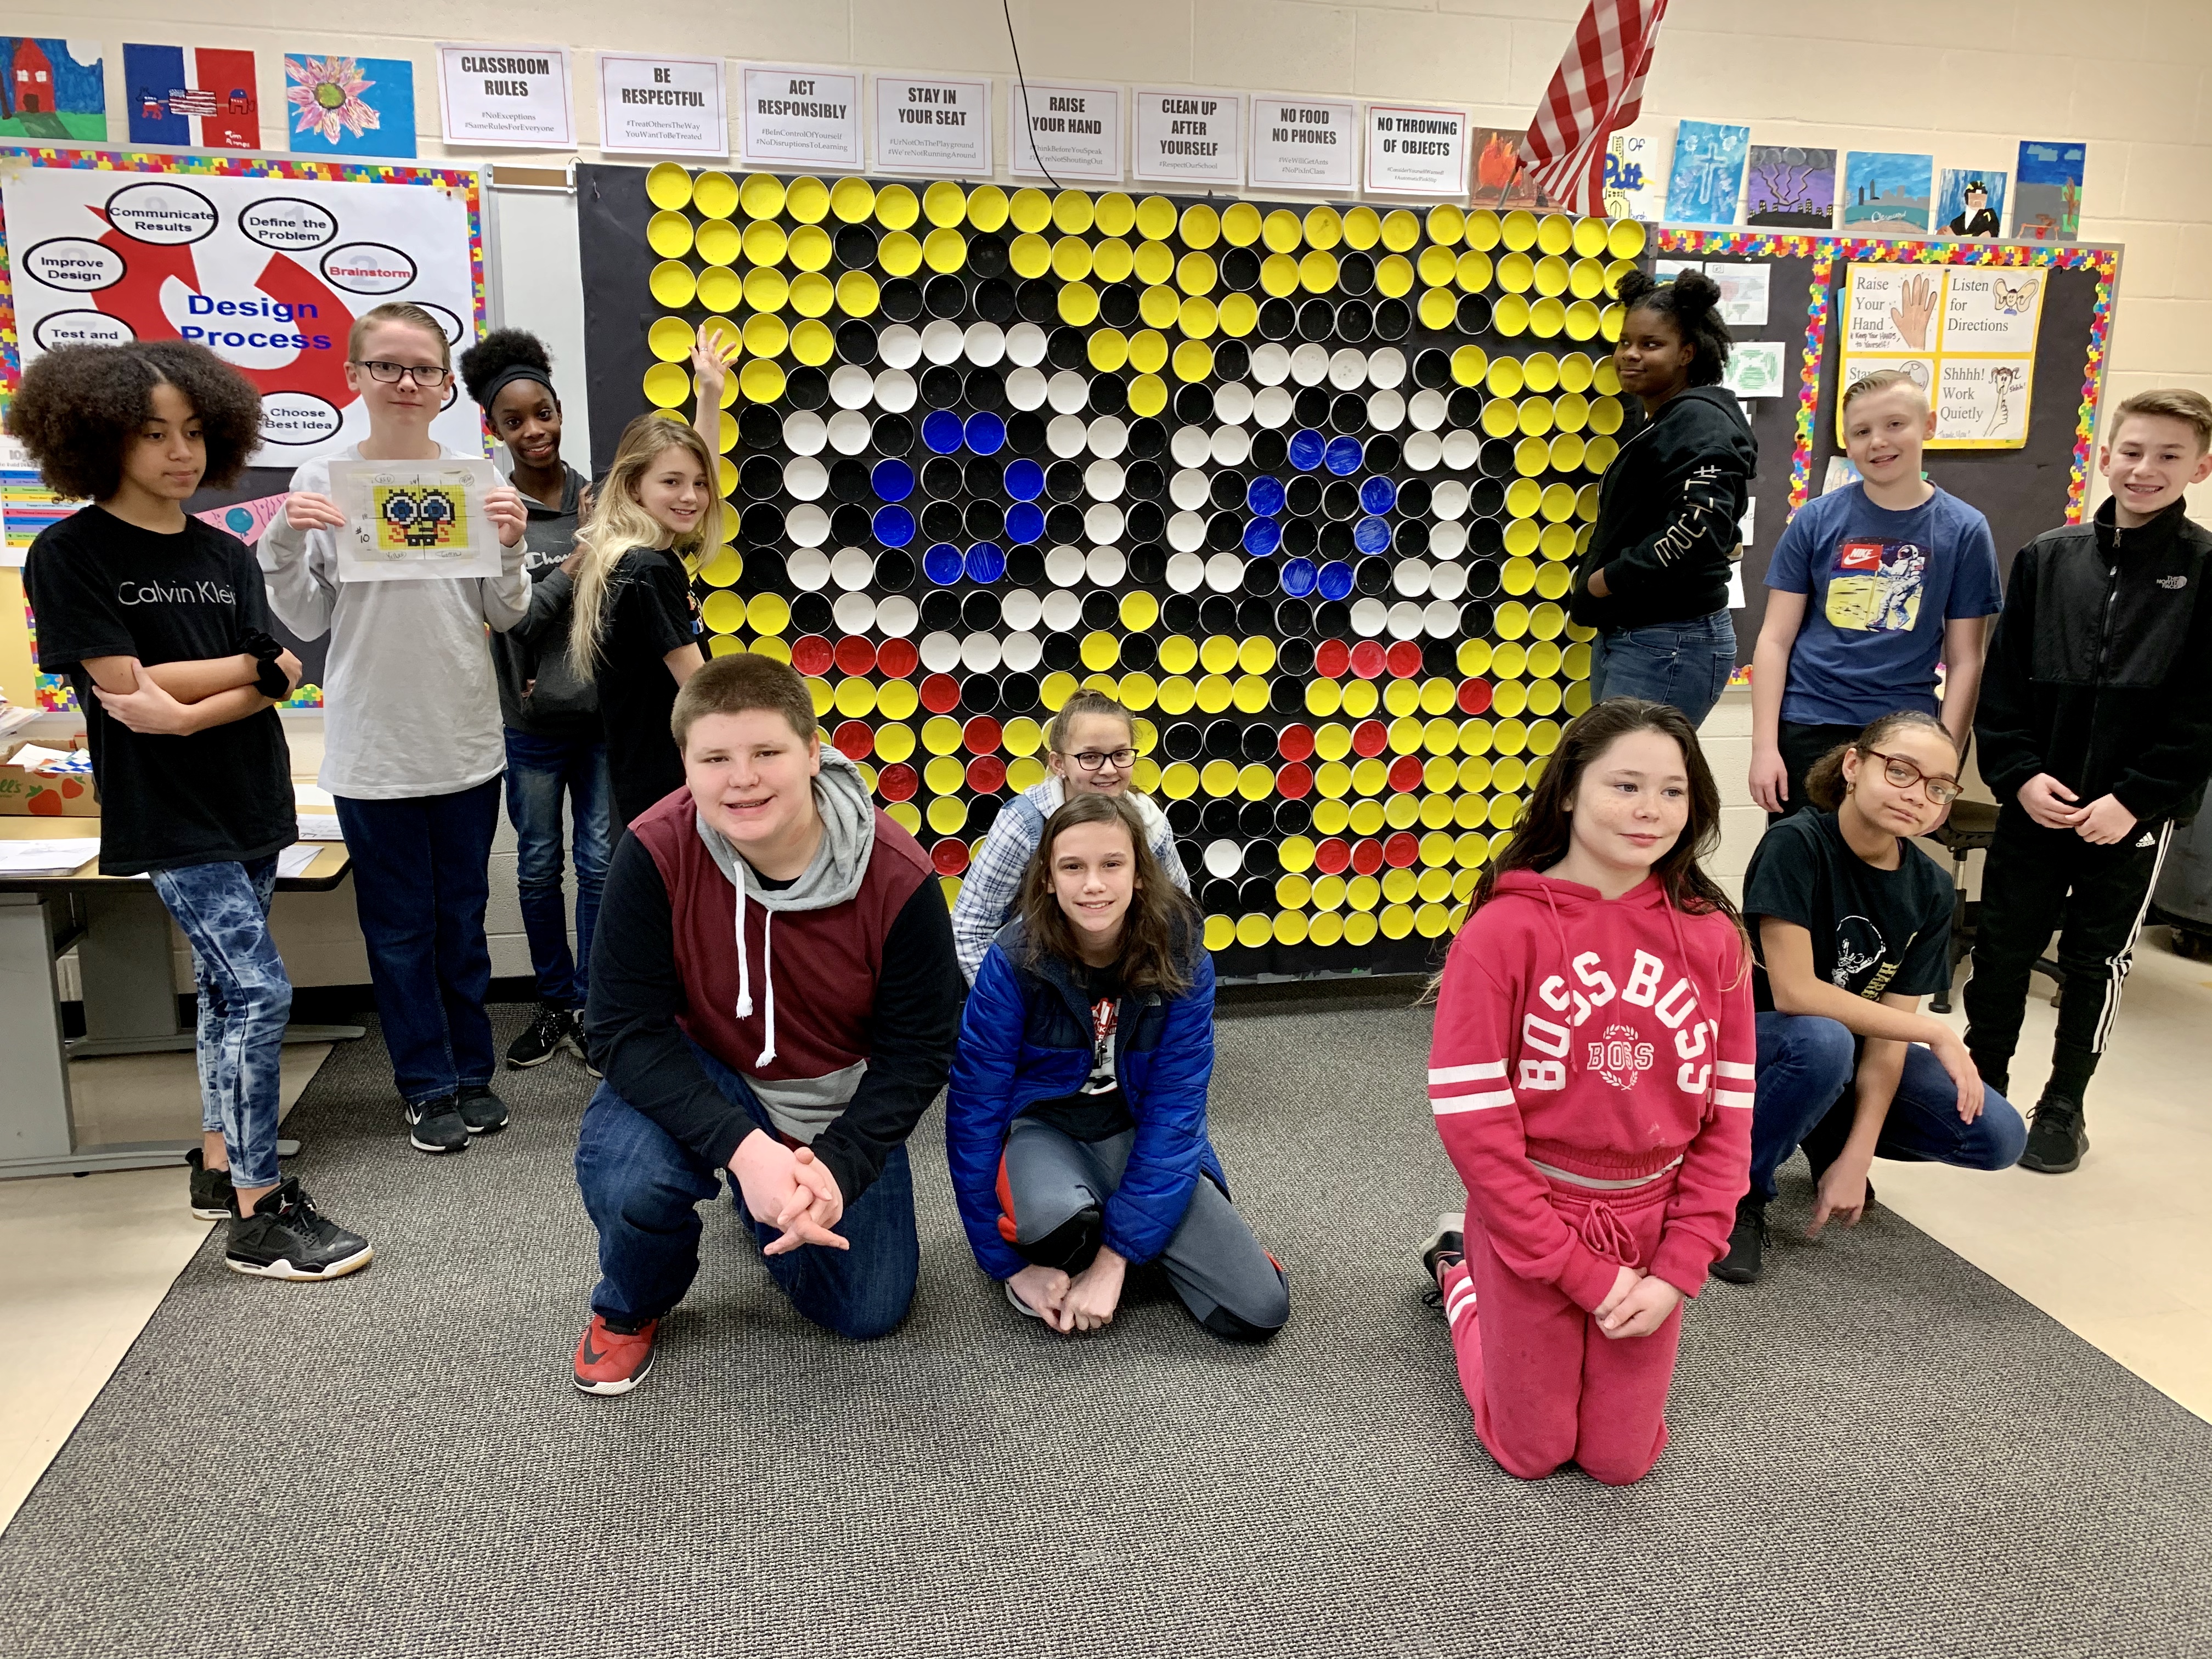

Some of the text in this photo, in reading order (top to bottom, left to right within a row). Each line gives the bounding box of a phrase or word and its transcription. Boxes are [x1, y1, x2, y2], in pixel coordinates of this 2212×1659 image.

[461, 57, 550, 75] CLASSROOM
[654, 67, 671, 83] BE
[484, 80, 528, 97] RULES
[789, 80, 815, 95] ACT
[622, 88, 705, 107] RESPECTFUL
[909, 87, 956, 104] STAY IN
[758, 99, 847, 119] RESPONSIBLY
[1049, 97, 1085, 112] RAISE
[1162, 99, 1217, 115] CLEAN UP
[482, 111, 536, 121] #NoExceptions
[898, 108, 967, 126] YOUR SEAT
[1281, 108, 1329, 124] NO FOOD
[465, 122, 554, 133] #SameRulesForEveryone
[627, 120, 701, 132] #TreatOthersTheWay
[1032, 117, 1102, 134] YOUR HAND
[1171, 120, 1206, 135] AFTER
[1378, 117, 1457, 136] NO THROWING
[625, 130, 702, 140] YouWantToBeTreated
[761, 128, 842, 140] #BeInControlOfYourself
[1272, 128, 1336, 145] NO PHONES
[756, 139, 848, 152] #NoDisruptionsToLearning
[890, 139, 974, 150] #UrNotOnThePlayground
[1160, 140, 1218, 156] YOURSELF
[1384, 139, 1450, 156] OF OBJECTS
[1629, 138, 1645, 151] Of
[888, 149, 976, 159] #We'reNotRunningAround
[1159, 161, 1217, 170] #RespectOurSchool
[1278, 157, 1328, 165] #WeWillGetAnts
[110, 207, 215, 221] Communicate
[135, 221, 192, 232] Results
[250, 217, 326, 228] Define the
[258, 230, 320, 241] Problem
[41, 256, 103, 268] Improve
[48, 269, 101, 281] Design
[329, 267, 411, 278] Brainstorm
[1857, 276, 1889, 290] Raise
[1951, 278, 1989, 291] Listen
[188, 295, 318, 322] Design
[1855, 297, 1884, 311] Your
[1950, 298, 1967, 311] for
[1853, 317, 1883, 330] Hand
[1948, 318, 2008, 331] Directions
[50, 329, 118, 340] Test and
[180, 325, 332, 349] Process
[1944, 367, 1985, 380] Shhhh!
[1943, 387, 1975, 400] Work
[270, 408, 325, 417] Choose
[1940, 407, 1984, 422] Quietly
[266, 420, 332, 430] Best Idea
[1850, 548, 1874, 557] NIKE
[119, 580, 236, 606] Calvin Klei
[1587, 1041, 1655, 1070] BOSS
